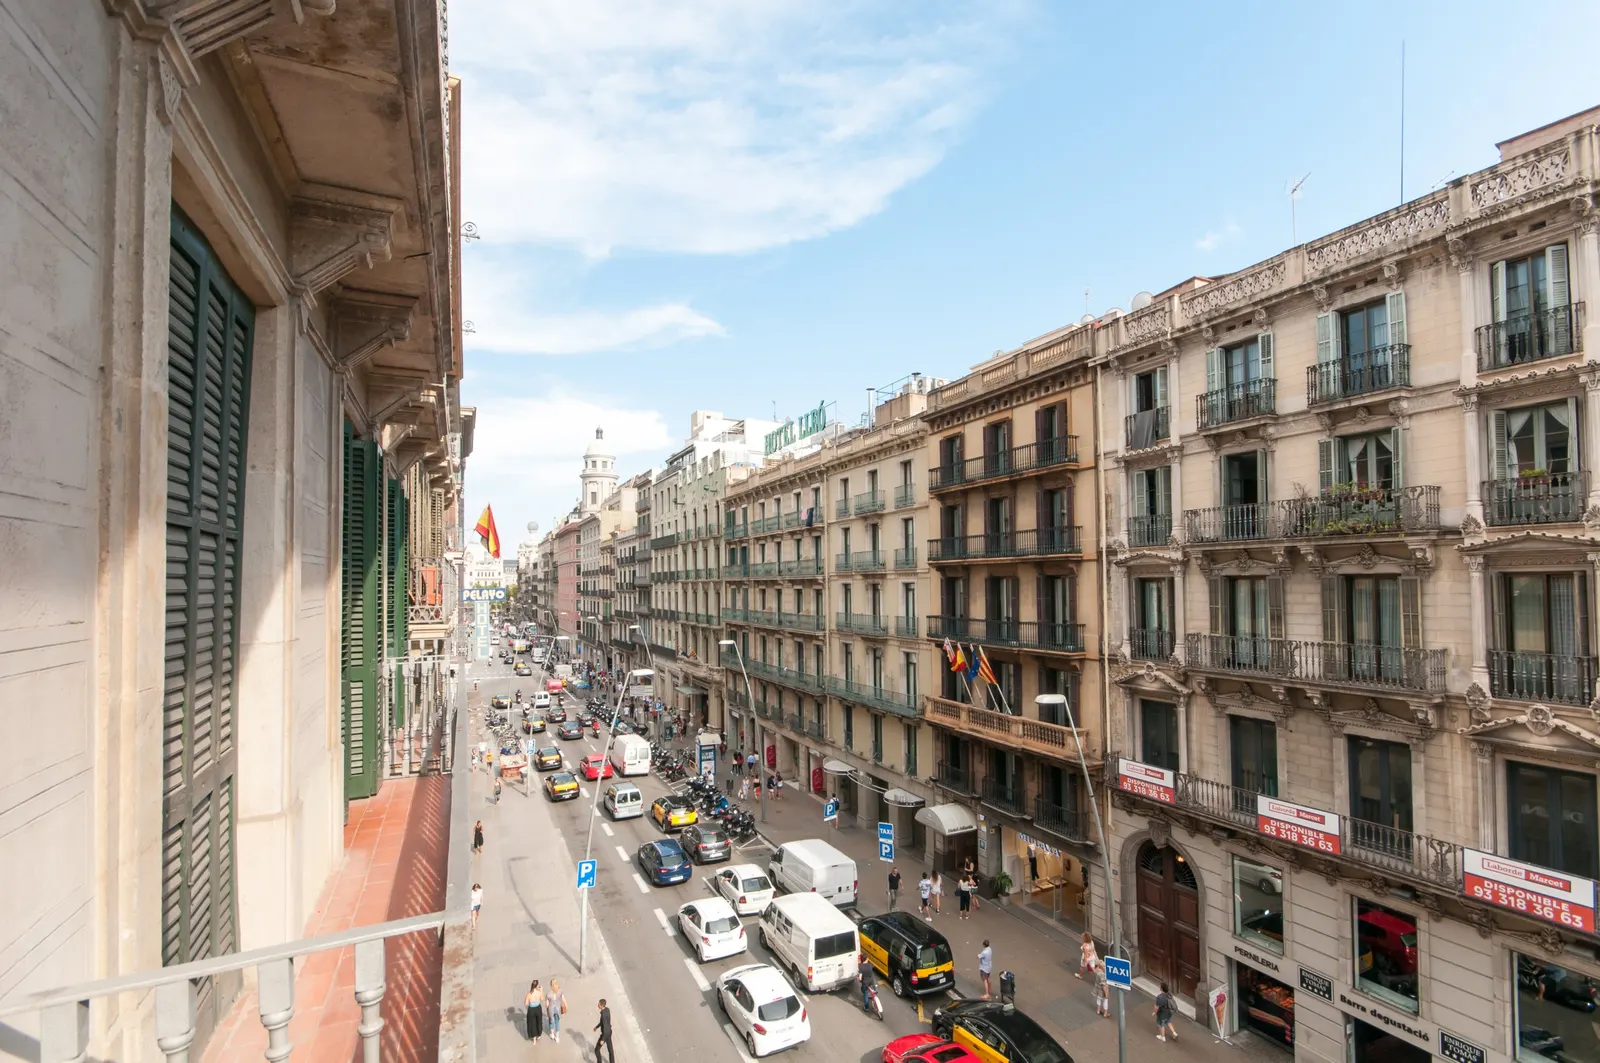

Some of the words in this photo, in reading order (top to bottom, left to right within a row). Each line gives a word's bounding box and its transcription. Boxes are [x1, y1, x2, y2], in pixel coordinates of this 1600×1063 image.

[764, 421, 796, 456] HOTEL
[463, 589, 505, 600] PELAYO
[477, 602, 488, 658] HOTEL
[1123, 782, 1131, 791] 93
[1134, 784, 1146, 795] 318
[1149, 789, 1158, 798] 36
[1160, 793, 1170, 802] 63
[1127, 777, 1164, 792] DISPONIBLE
[827, 804, 834, 816] P
[1264, 825, 1276, 836] 93
[1280, 829, 1298, 842] 318
[1302, 835, 1315, 847] 36
[1318, 840, 1333, 852] 63
[1270, 820, 1325, 840] DISPONIBLE
[882, 843, 890, 856] P
[580, 863, 593, 878] P
[1487, 861, 1523, 876] Laborde
[1529, 872, 1564, 888] Marcet
[1484, 880, 1570, 912] DISPONIBLE
[1474, 885, 1492, 901] 93
[1499, 893, 1527, 910] 318
[1533, 903, 1554, 919] 36
[1560, 912, 1584, 928] 63
[1234, 945, 1280, 973] PERNILERIA
[1106, 965, 1129, 977] TAXI
[1301, 970, 1330, 987] ENRIQUE
[1340, 994, 1366, 1013] Barra
[1370, 1008, 1430, 1042] degustació
[1444, 1035, 1481, 1056] ENRIQUE
